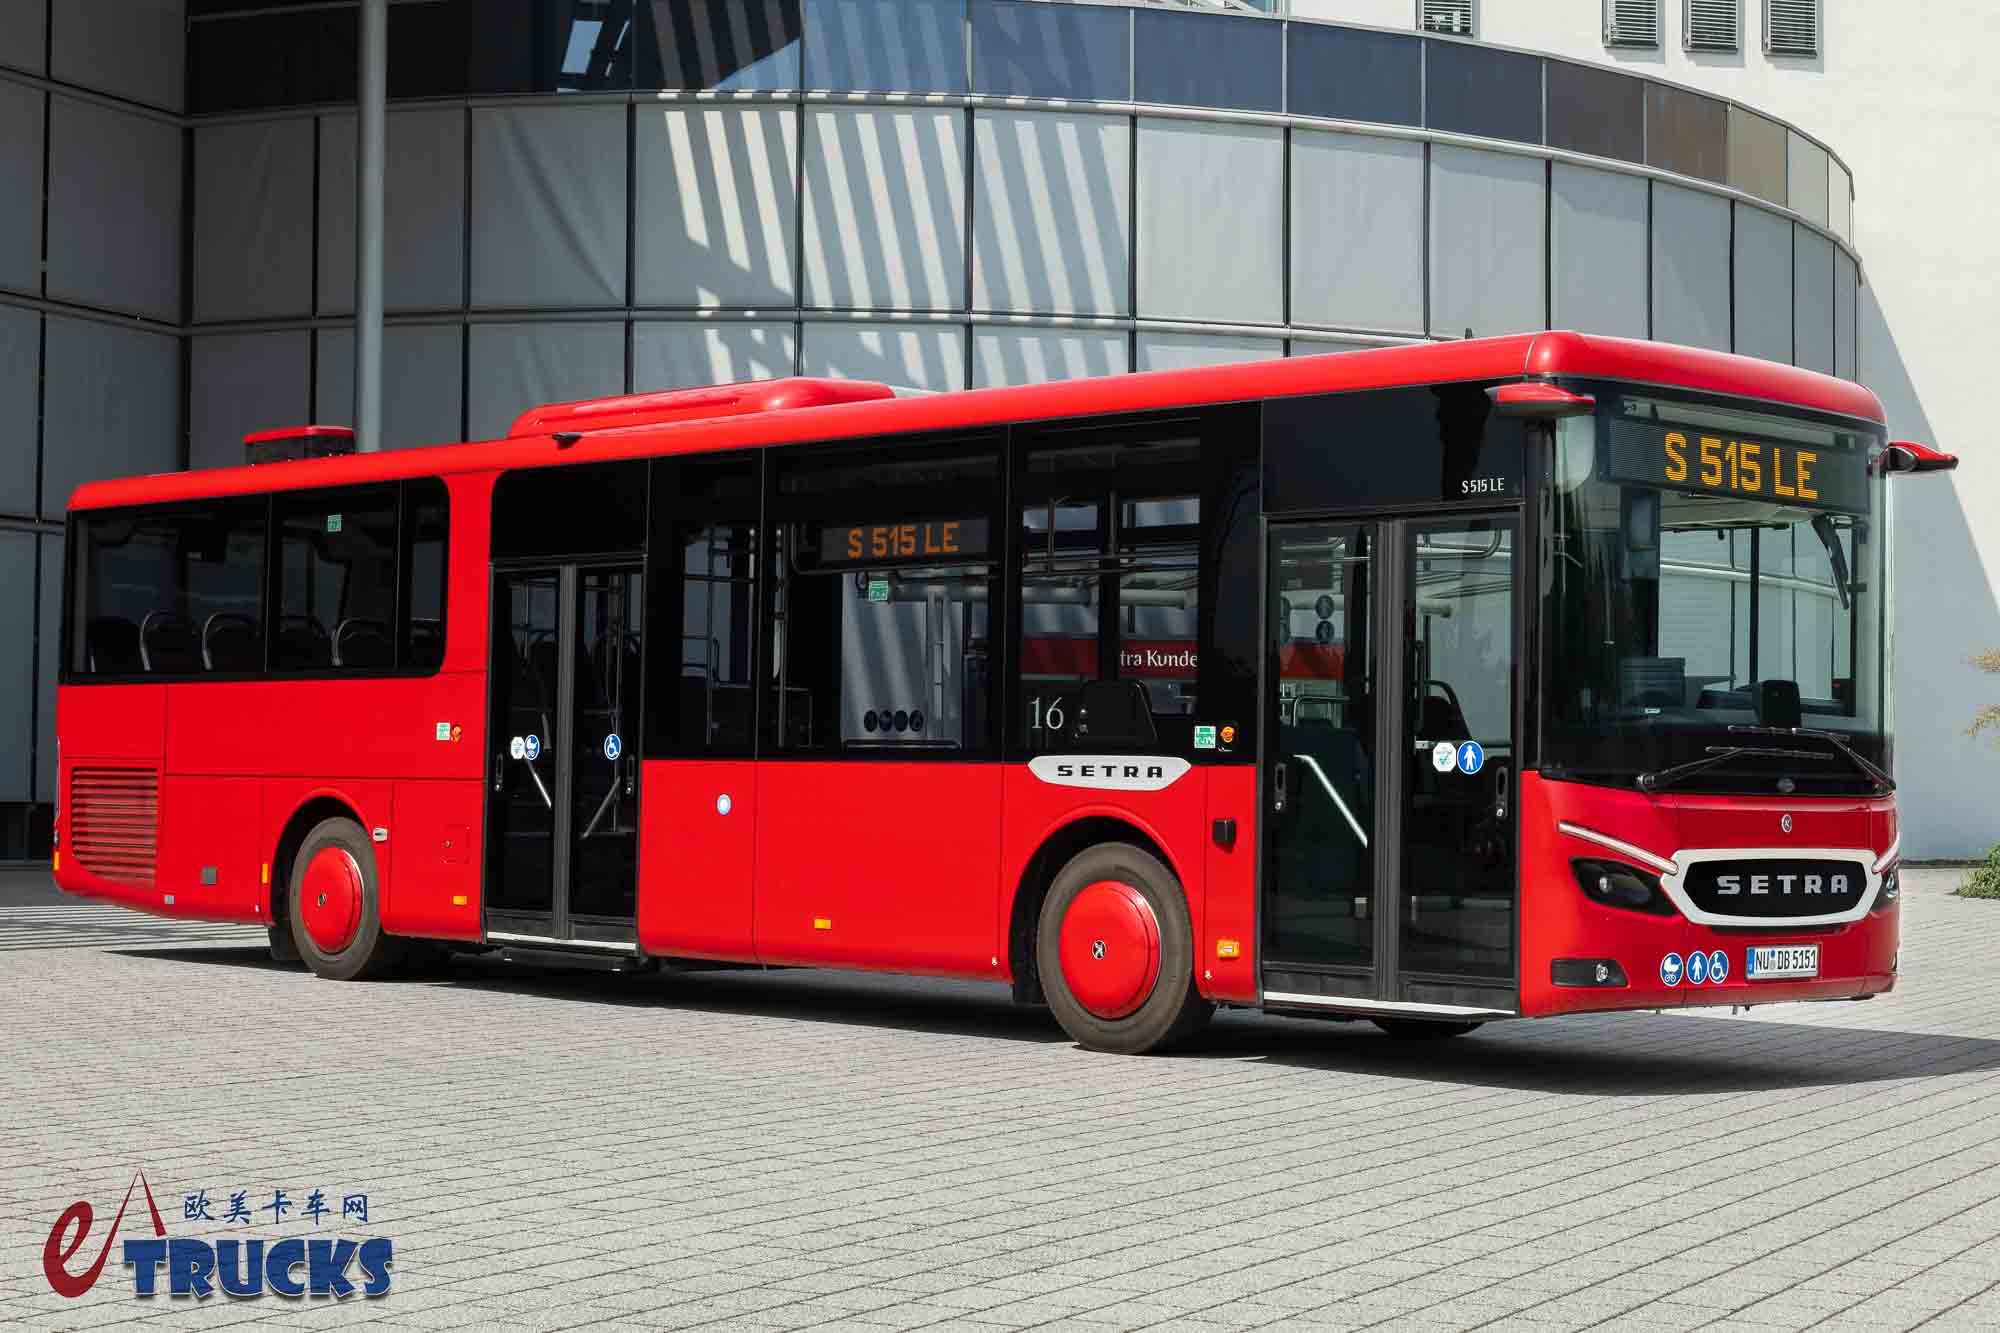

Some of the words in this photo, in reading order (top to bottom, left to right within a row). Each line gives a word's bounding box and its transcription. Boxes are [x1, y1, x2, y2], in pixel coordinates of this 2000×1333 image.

[1664, 432, 1687, 481] S
[1700, 437, 1761, 491] 515
[1773, 448, 1818, 499] LE
[1461, 480, 1469, 494] S
[1470, 479, 1488, 493] 515
[1489, 477, 1505, 492] LE
[847, 527, 864, 560] S
[871, 524, 916, 558] 515
[923, 521, 961, 554] LE
[1030, 697, 1065, 730] 16
[1057, 764, 1163, 779] SETRA
[1716, 874, 1849, 895] SETRA
[1755, 951, 1769, 971] NU
[1776, 950, 1790, 970] DB
[1792, 949, 1817, 969] 5151
